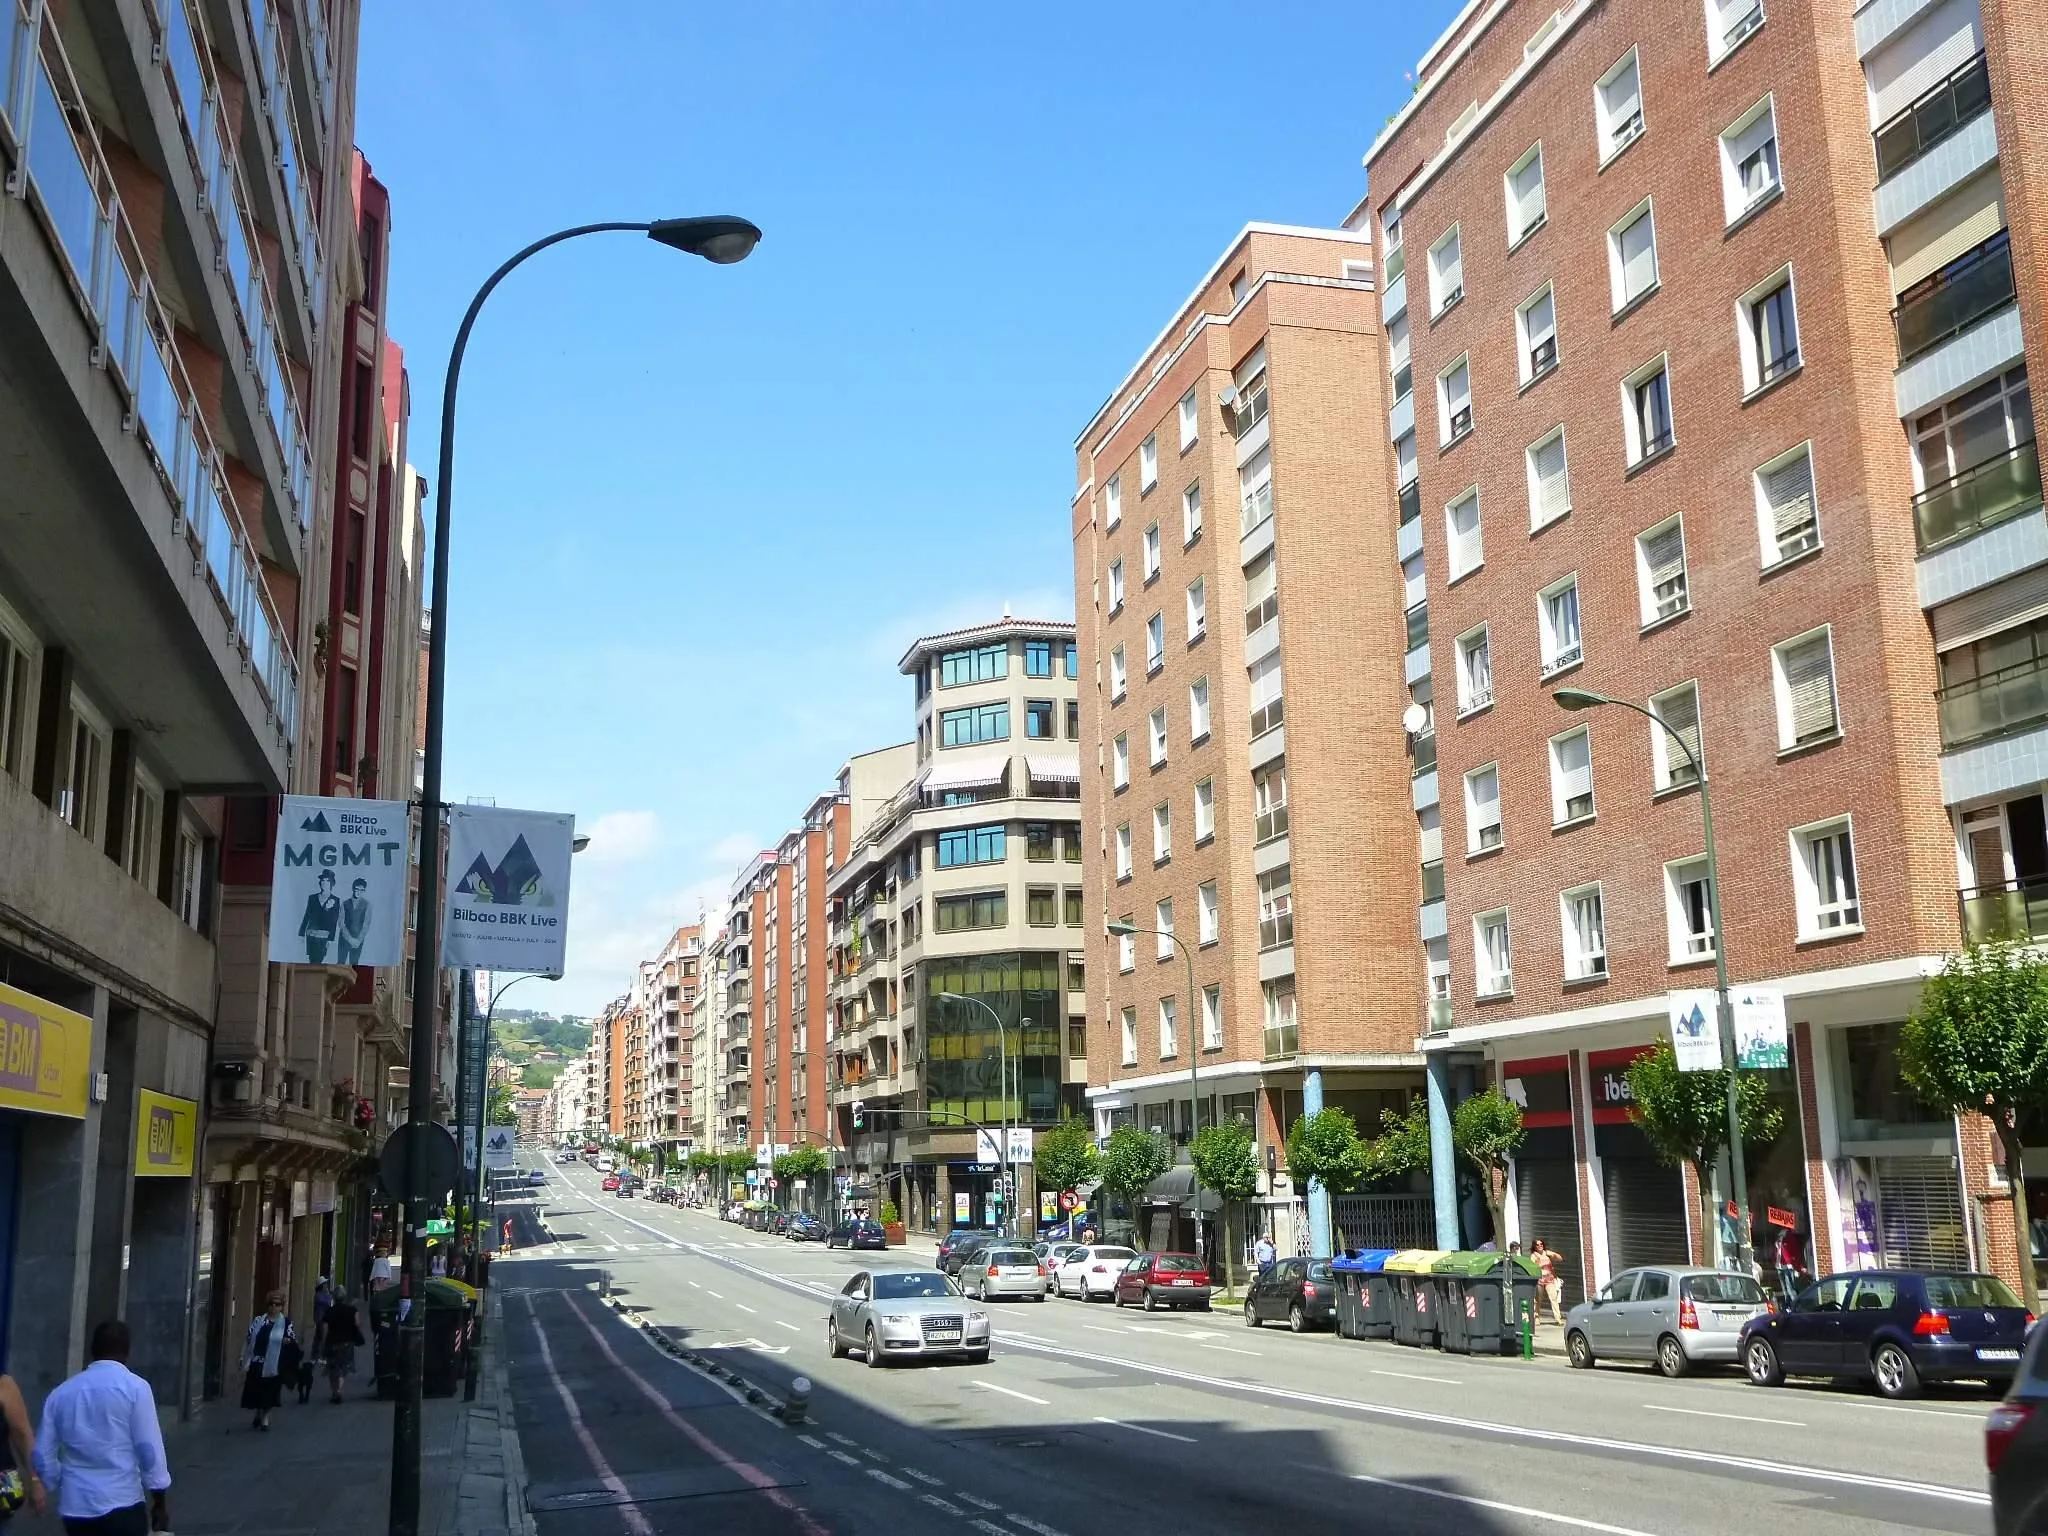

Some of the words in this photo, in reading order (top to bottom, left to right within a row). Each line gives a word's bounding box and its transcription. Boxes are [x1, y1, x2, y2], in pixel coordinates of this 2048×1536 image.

[340, 813, 378, 825] Bilbao
[340, 824, 363, 835] BBK
[365, 825, 388, 836] Live
[283, 842, 400, 867] MGMT
[453, 908, 497, 923] Bilbao
[500, 912, 528, 926] BBK
[531, 913, 558, 927] Live
[1604, 1073, 1637, 1101] ibe
